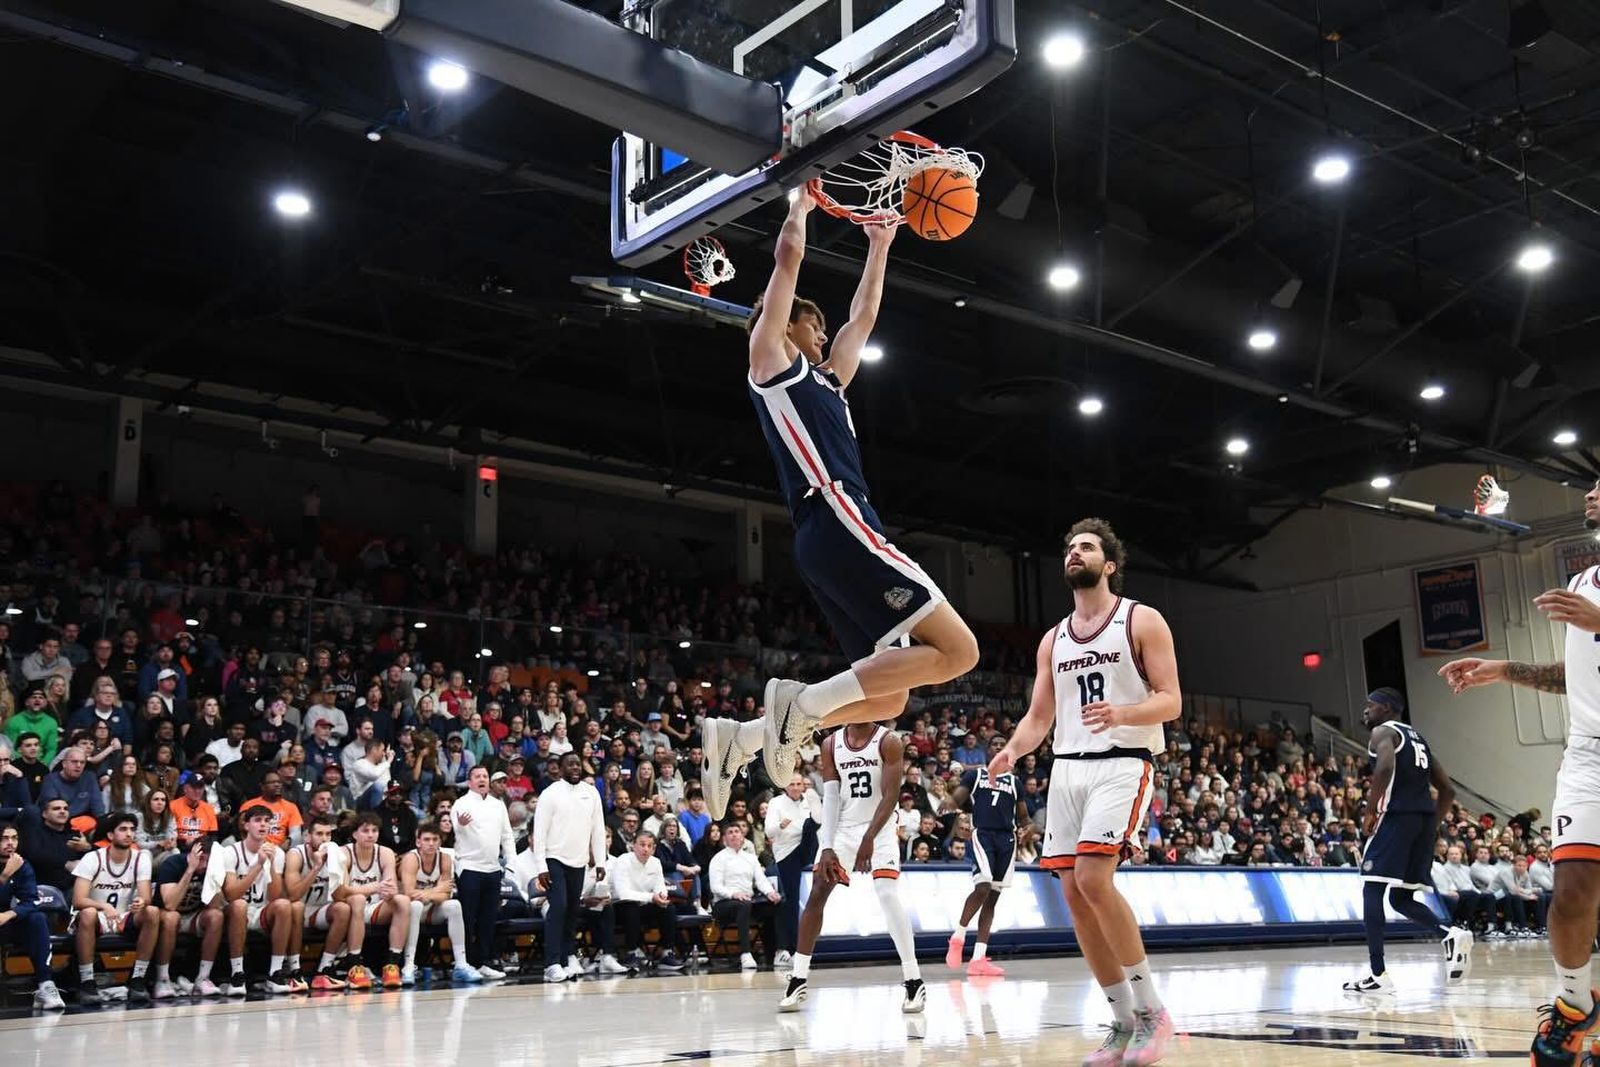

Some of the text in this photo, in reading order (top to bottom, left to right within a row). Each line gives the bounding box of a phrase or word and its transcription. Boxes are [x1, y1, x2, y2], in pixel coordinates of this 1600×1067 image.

[125, 425, 136, 441] D
[484, 484, 491, 498] C
[1057, 650, 1121, 673] PEPPERDINE
[1076, 671, 1105, 707] 18
[1411, 740, 1429, 769] 15
[848, 771, 873, 798] 23
[991, 790, 1001, 807] 7
[1556, 815, 1573, 836] P
